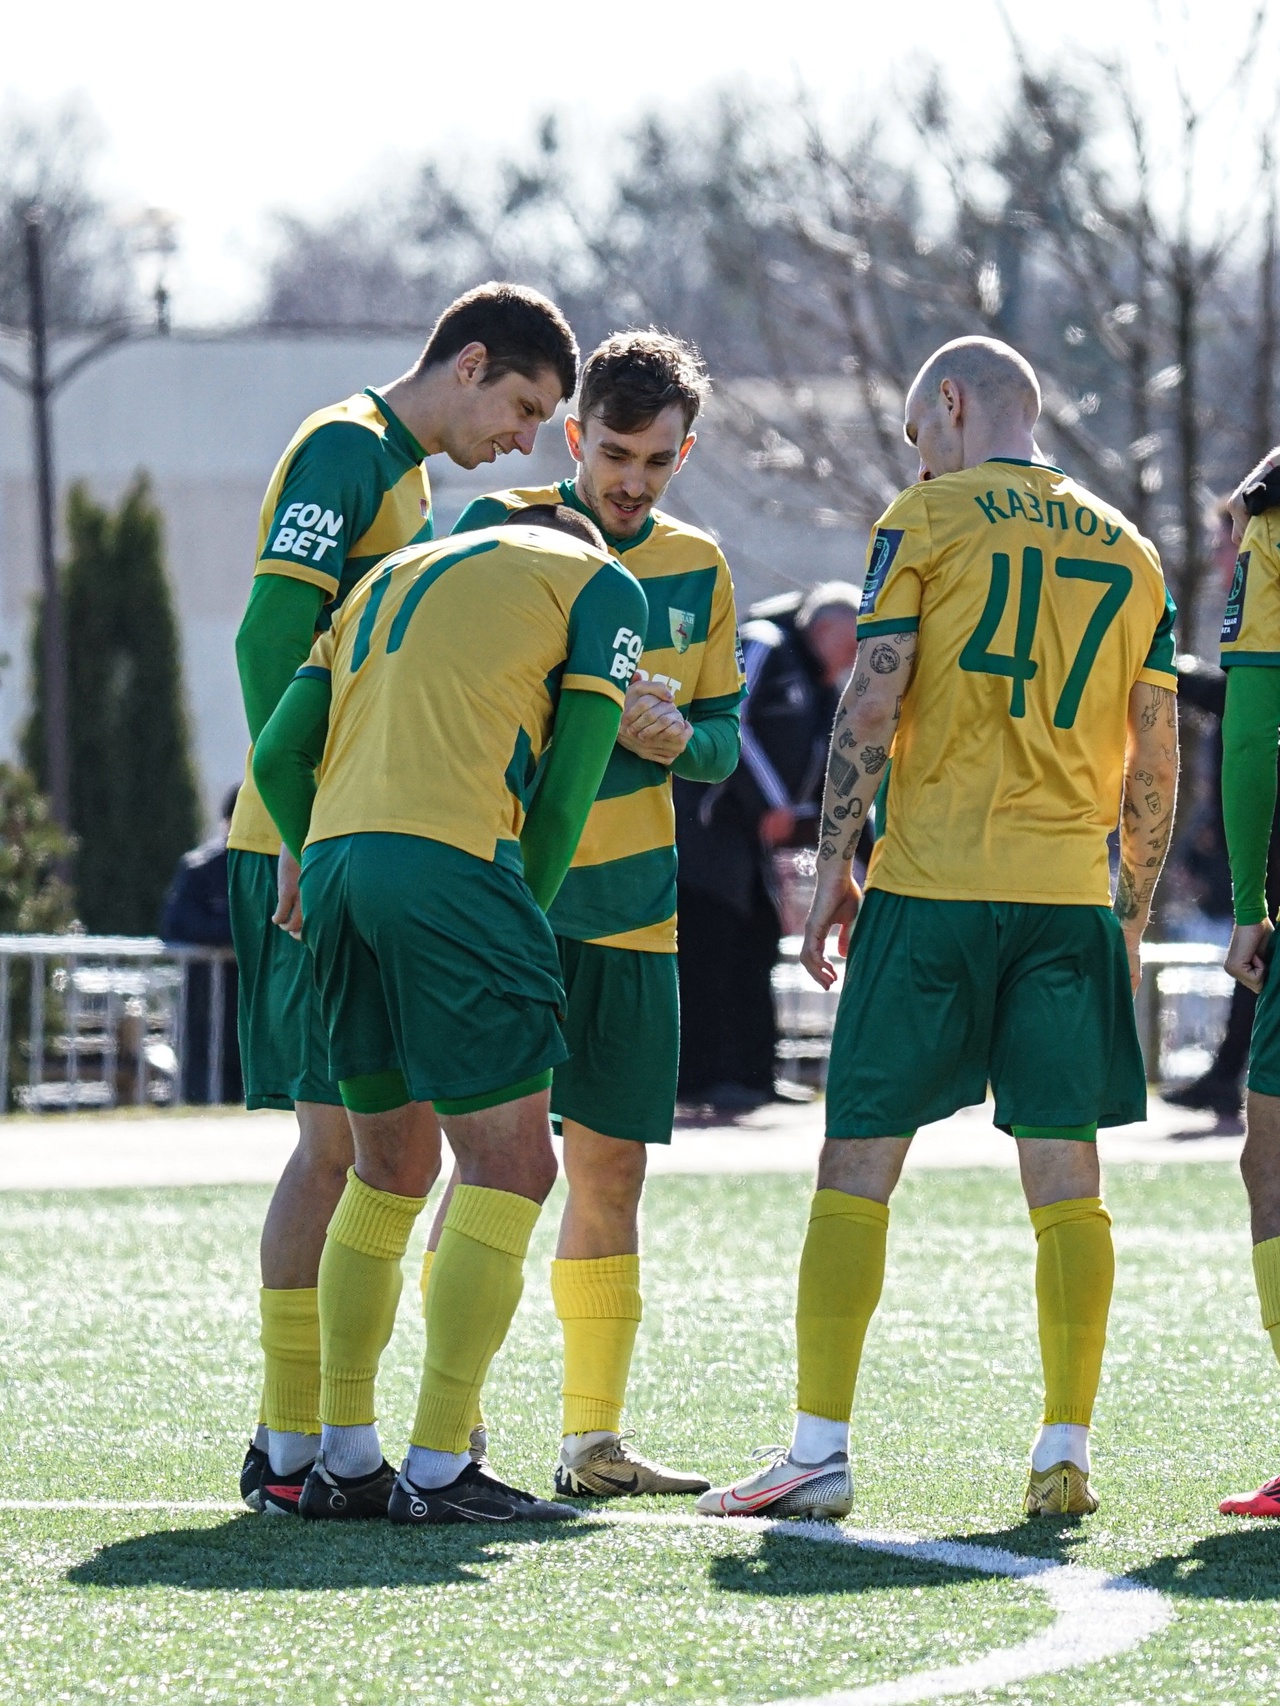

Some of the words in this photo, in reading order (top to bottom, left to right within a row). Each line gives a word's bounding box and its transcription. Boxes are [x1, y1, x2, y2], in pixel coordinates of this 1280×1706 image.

[279, 502, 344, 537] FON
[271, 527, 338, 562] BET
[612, 627, 645, 664] FO
[958, 546, 1133, 730] 47
